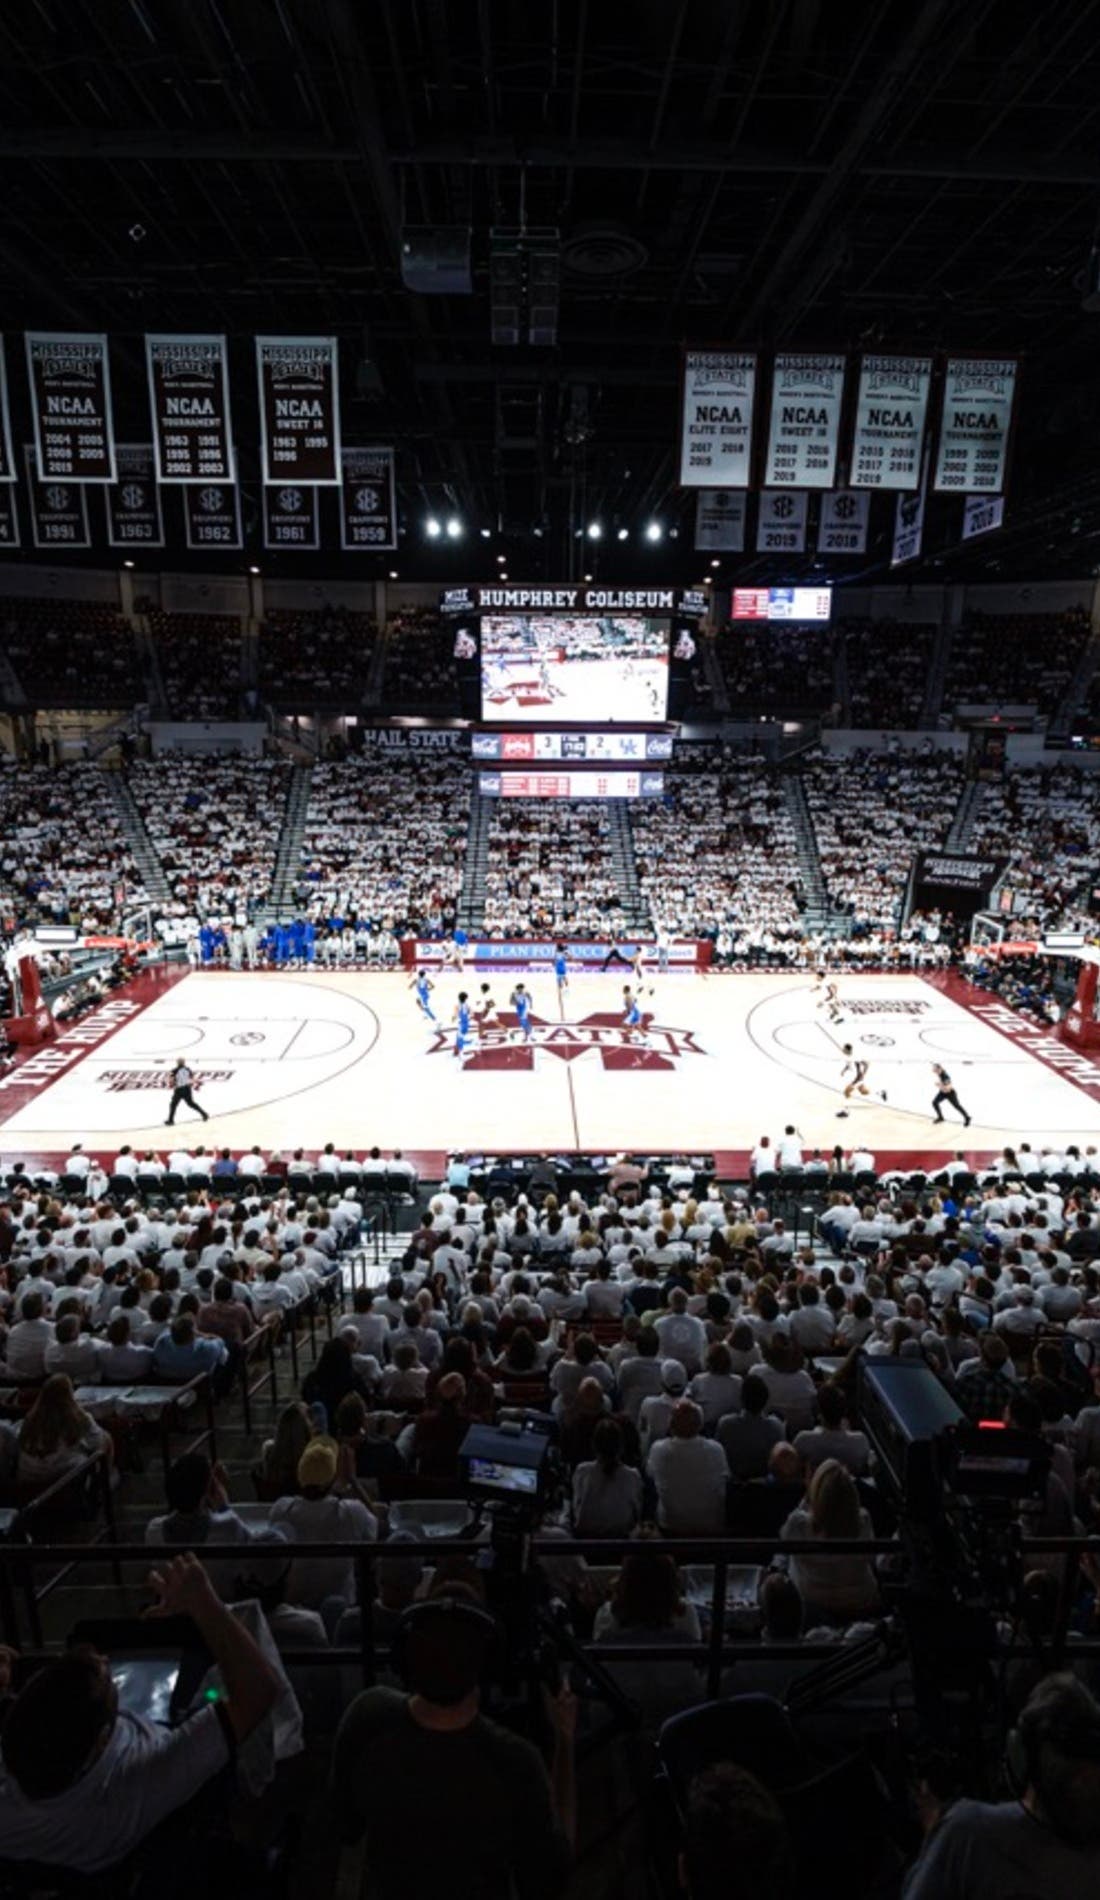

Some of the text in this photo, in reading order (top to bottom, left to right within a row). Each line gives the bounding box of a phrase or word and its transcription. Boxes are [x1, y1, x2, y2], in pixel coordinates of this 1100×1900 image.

[47, 396, 96, 414] NCAA
[166, 397, 215, 415] NCAA
[275, 399, 323, 417] NCAA
[696, 405, 742, 423] NCAA
[782, 407, 828, 424] NCAA
[868, 408, 913, 428] NCAA
[953, 411, 999, 429] NCAA
[42, 416, 103, 427] TOURNAMENT
[162, 417, 221, 428] TOURNAMENT
[276, 419, 309, 430] SWEET
[689, 424, 717, 435] ELITE
[781, 427, 813, 437] SWEET
[861, 429, 917, 440] TOURNAMENT
[947, 430, 1003, 441] TOURNAMENT
[858, 460, 882, 471] 2017
[120, 525, 152, 538] 1963
[197, 526, 231, 540] 1962
[275, 526, 306, 540] 1961
[353, 527, 386, 541] 1959
[765, 534, 799, 547] 2019
[479, 590, 577, 606] HUMPHREY
[586, 591, 673, 608] COLISEUM
[364, 729, 406, 746] HAIL
[409, 729, 461, 747] STATE
[491, 946, 528, 957] PLAN
